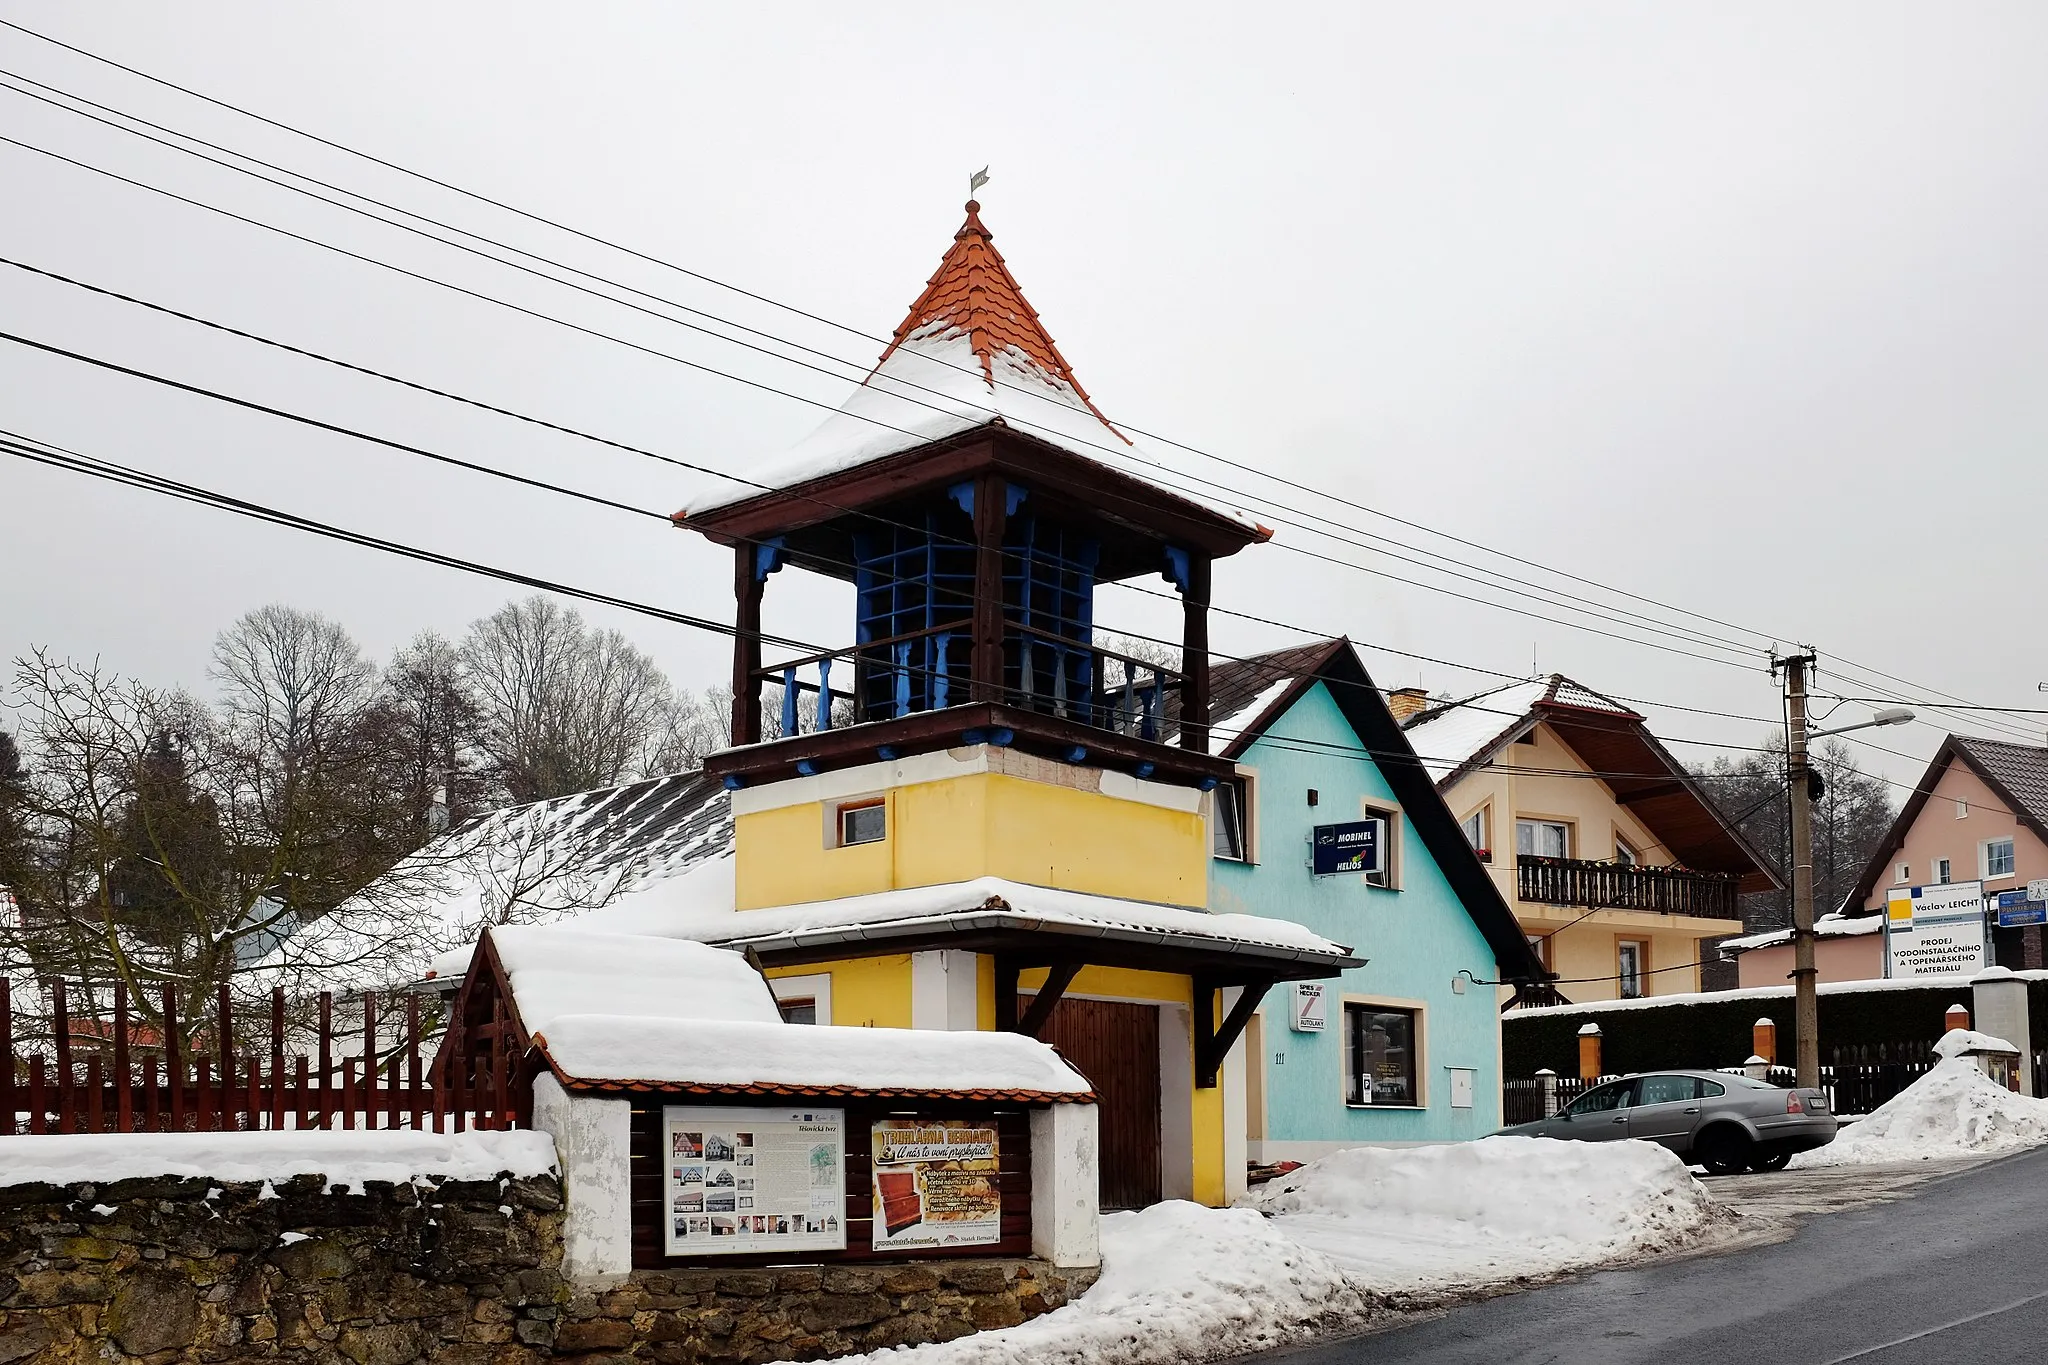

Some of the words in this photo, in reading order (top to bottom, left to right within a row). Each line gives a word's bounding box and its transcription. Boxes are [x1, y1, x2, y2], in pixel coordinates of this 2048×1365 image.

[1338, 831, 1372, 843] MOBIHEL
[1336, 861, 1362, 871] HELIOS
[1915, 902, 1946, 912] Václav
[1948, 899, 1979, 909] LEICHT
[1921, 937, 1953, 946] PRODEJ
[1893, 944, 1981, 958] VODOINSTALAČNÍHO
[1899, 959, 1906, 967] A
[1908, 953, 1976, 966] TOPENÁŘSKÉHO
[1915, 963, 1961, 975] MATERIÁLU
[1299, 990, 1321, 998] HECKER
[1300, 1019, 1324, 1027] AUTOLAKY
[1275, 1052, 1285, 1065] 111
[884, 1128, 944, 1145] TRUHLÁRNA
[947, 1129, 992, 1145] BERNARD
[896, 1145, 907, 1159] U
[906, 1147, 920, 1158] nás
[921, 1145, 930, 1158] to
[931, 1146, 948, 1157] voní
[926, 1170, 947, 1178] Nábytek
